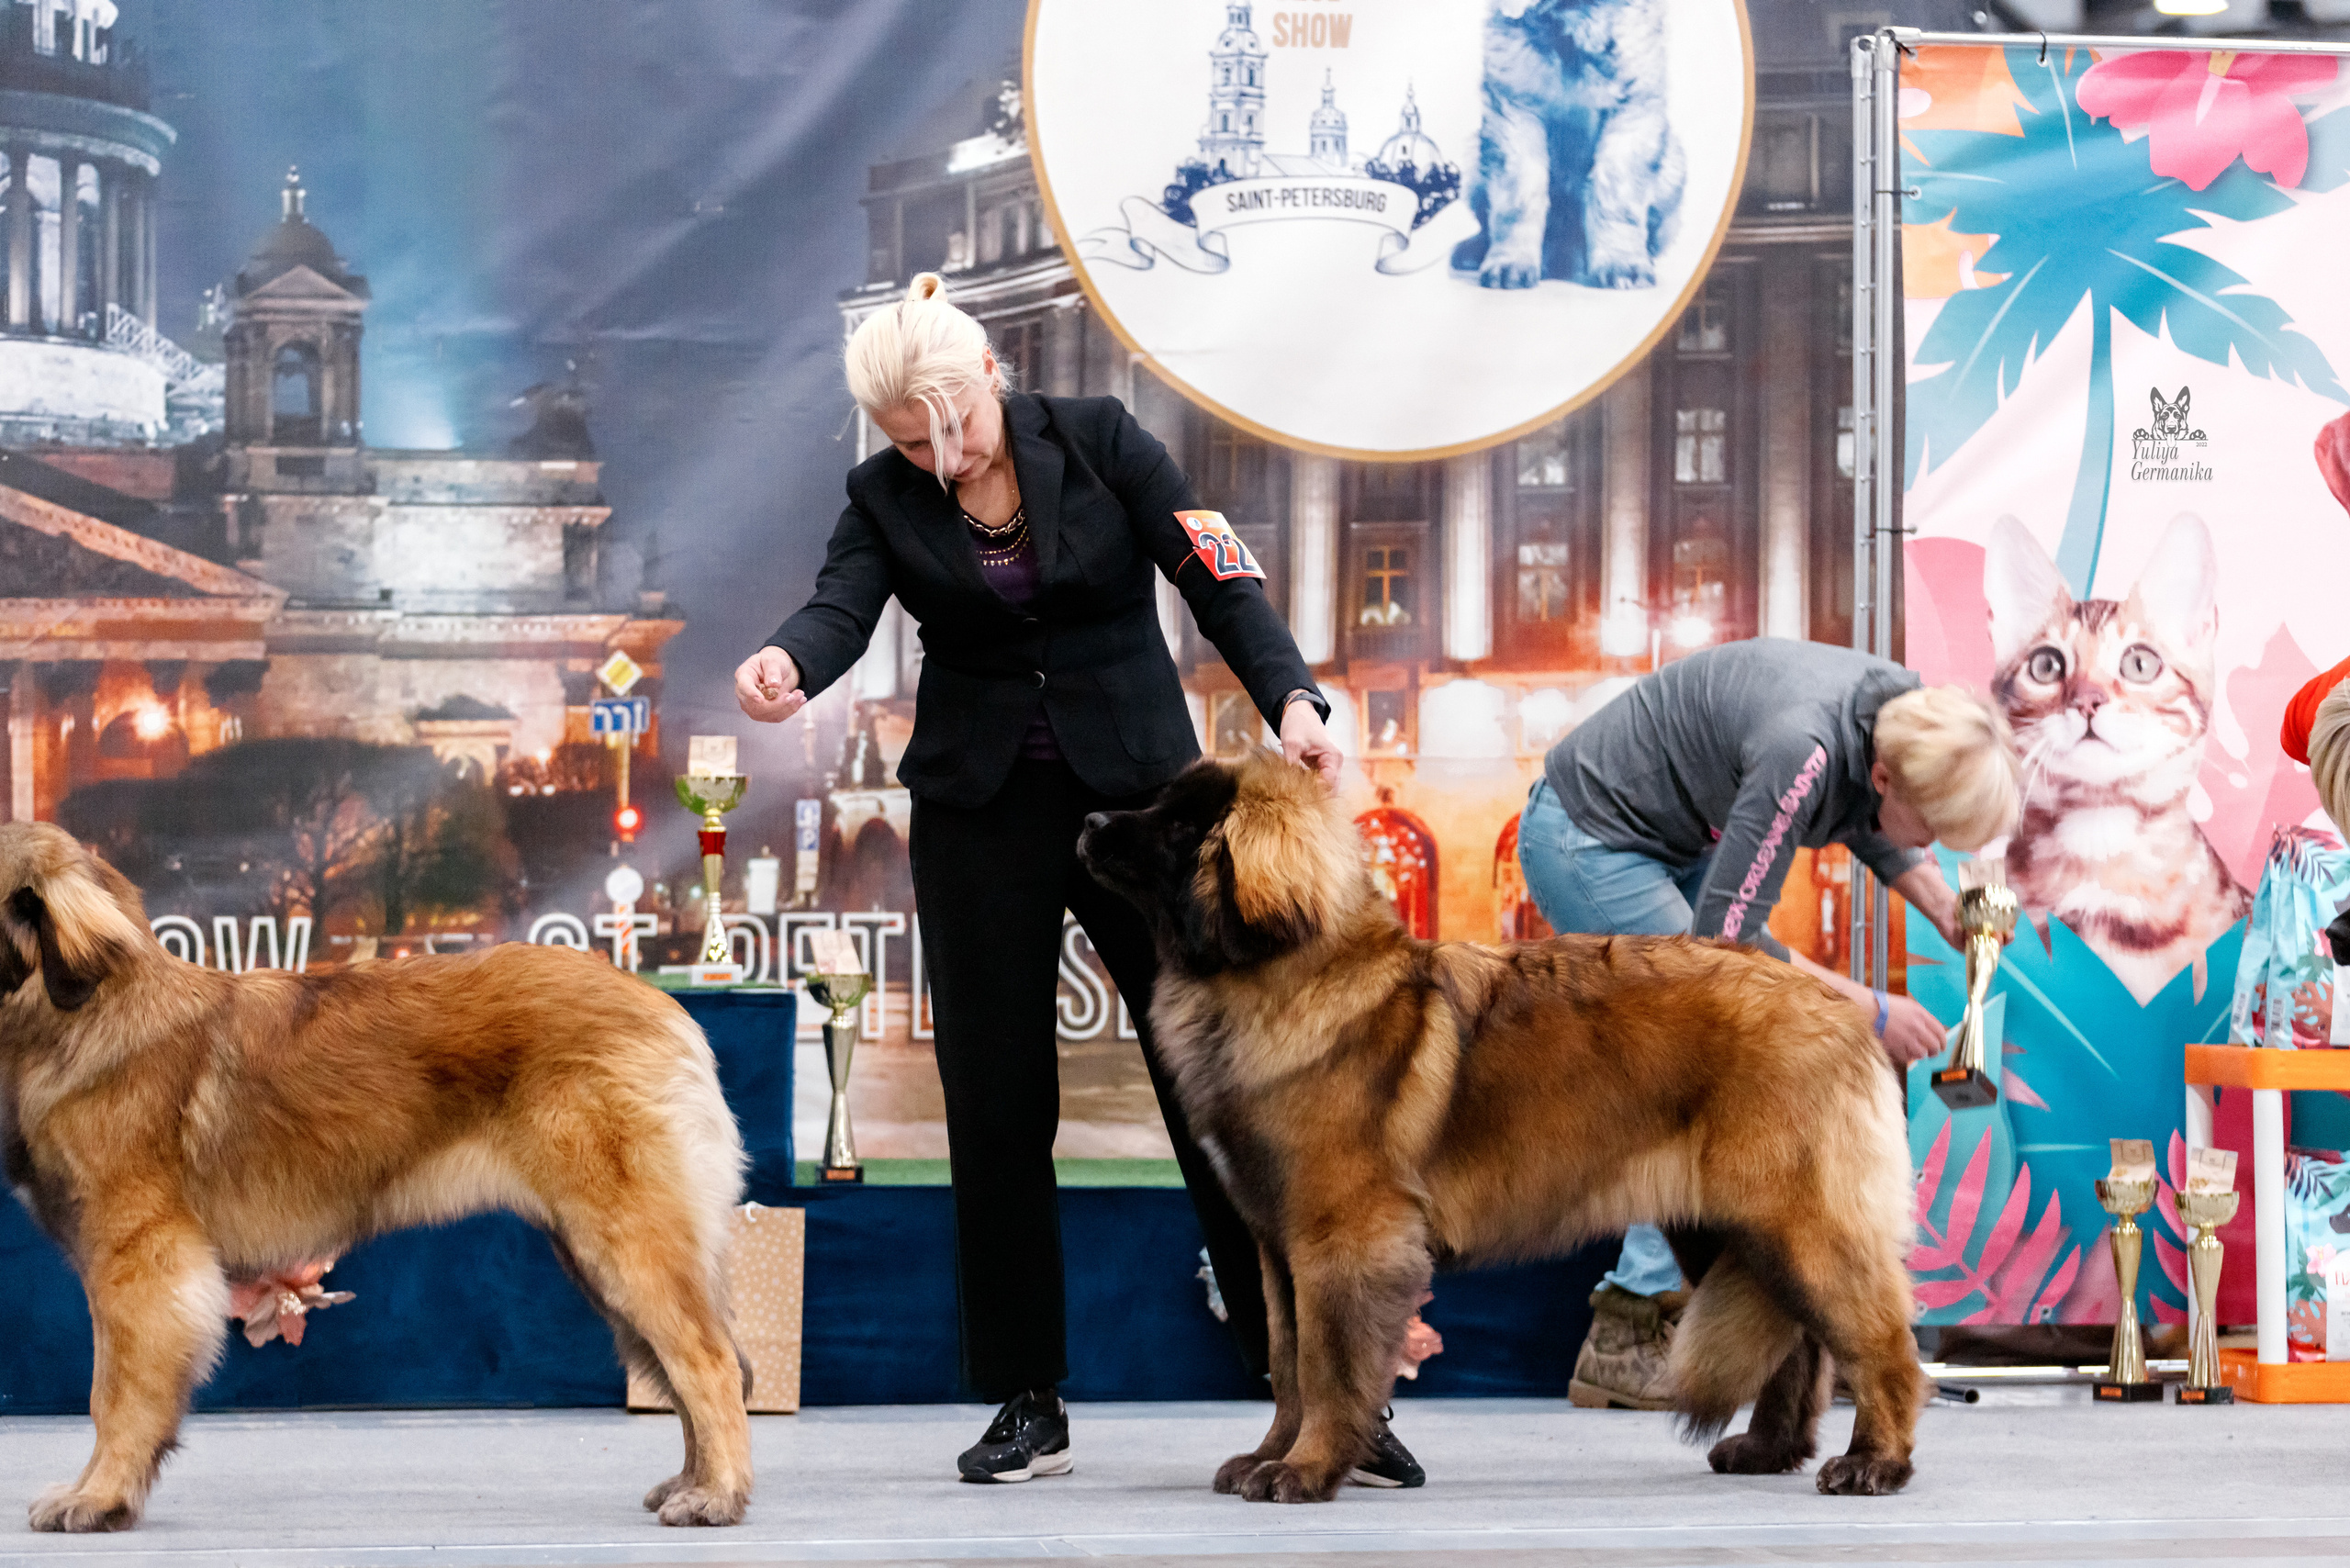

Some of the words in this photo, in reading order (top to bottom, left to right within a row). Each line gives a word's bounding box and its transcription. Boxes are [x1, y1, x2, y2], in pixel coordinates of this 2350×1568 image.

[1272, 11, 1353, 49] SHOW
[1226, 187, 1387, 213] SAINT-PETERSBURG
[1198, 532, 1261, 577] 22
